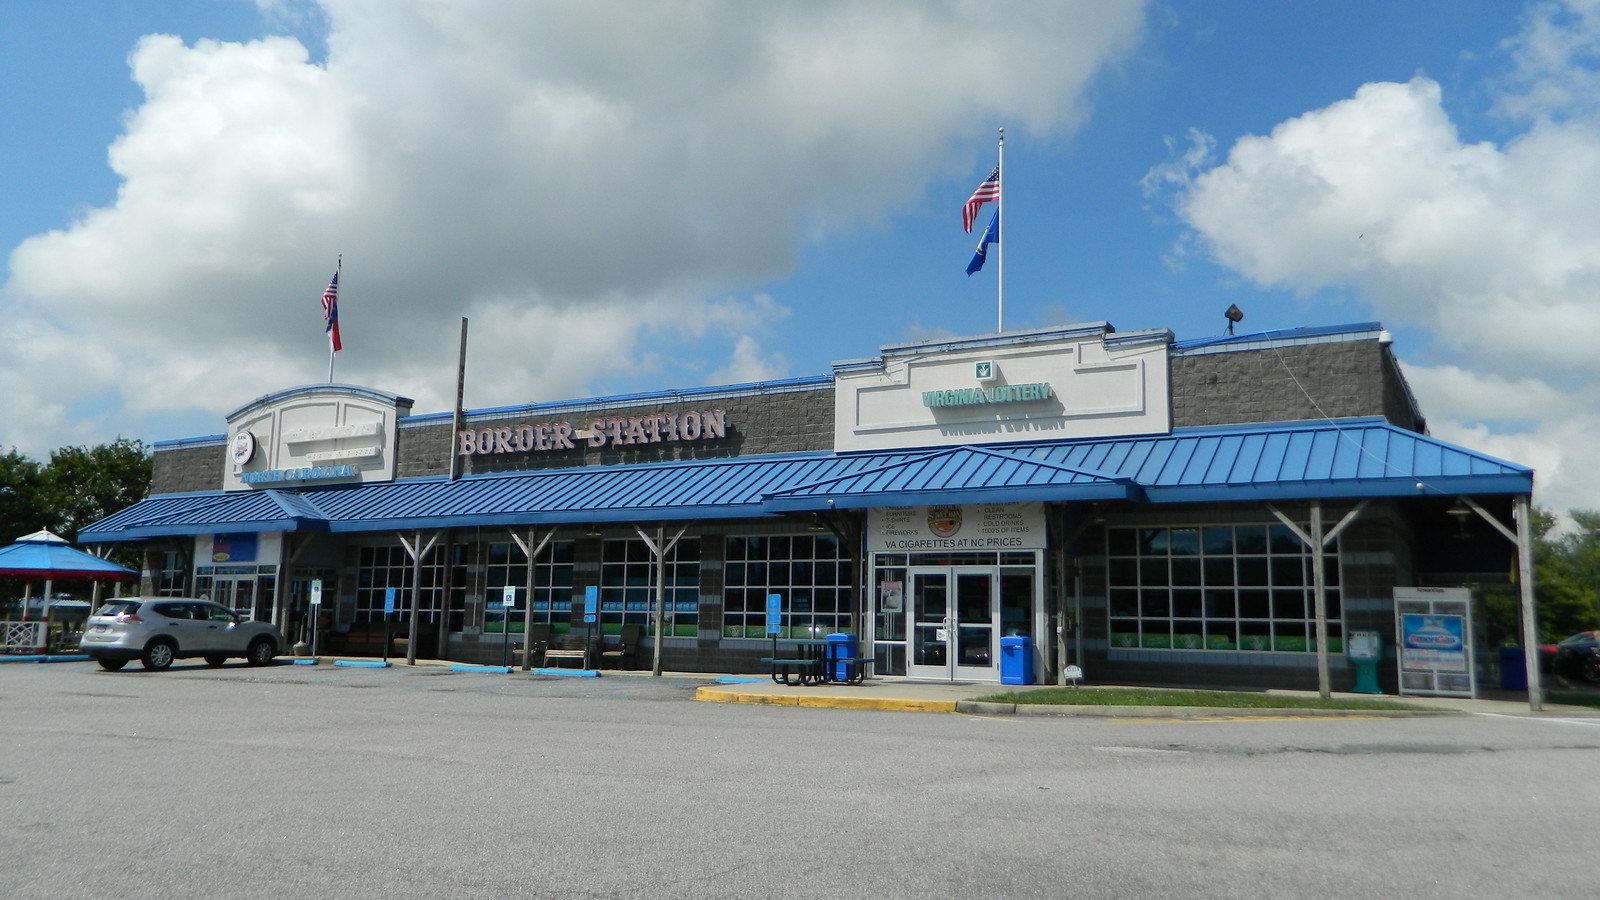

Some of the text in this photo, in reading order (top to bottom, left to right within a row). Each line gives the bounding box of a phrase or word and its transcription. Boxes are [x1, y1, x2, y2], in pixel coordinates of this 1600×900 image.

[922, 382, 1050, 408] VIRGINIA LOTTERY
[458, 409, 727, 456] BORDER STATION
[240, 464, 353, 483] NORTH CAROLINA
[984, 506, 1005, 514] CLEAN
[885, 537, 1023, 549] VA CIGARETTES AT NC PRICES
